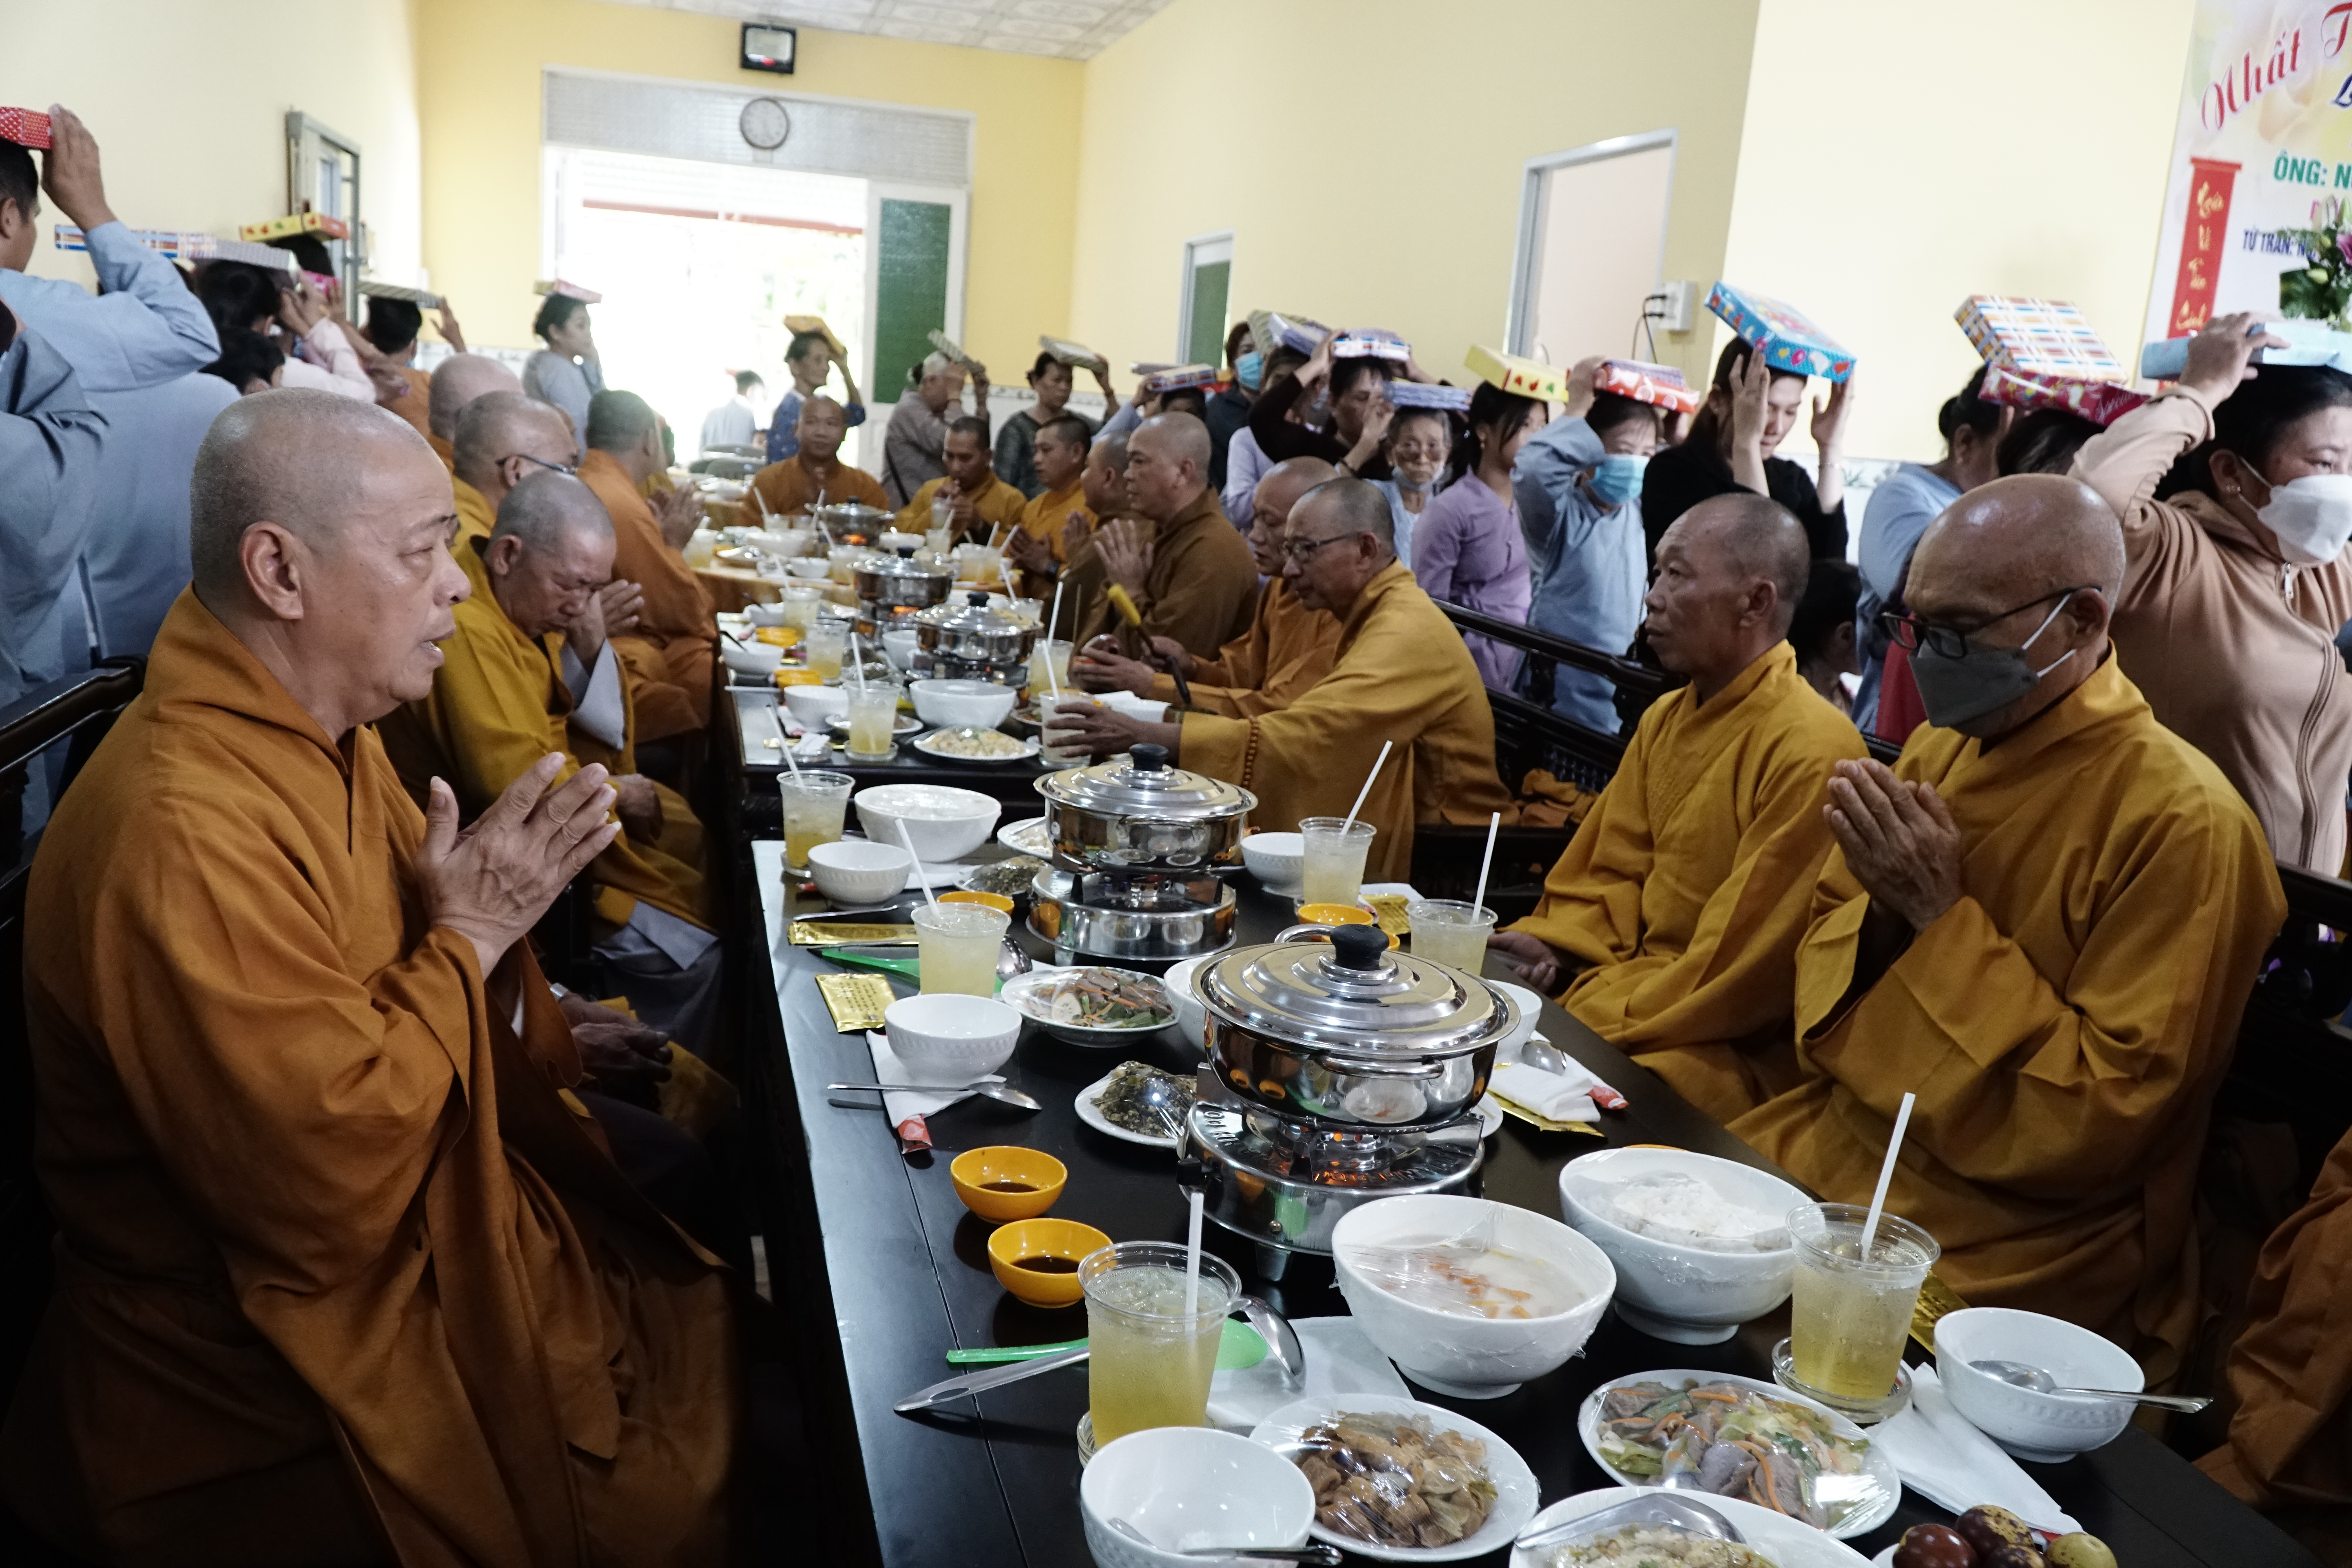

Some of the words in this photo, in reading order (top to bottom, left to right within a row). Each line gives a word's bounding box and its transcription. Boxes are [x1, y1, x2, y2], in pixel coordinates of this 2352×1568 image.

[2201, 27, 2303, 131] Nhất
[2274, 150, 2327, 186] ÔNG:
[2334, 162, 2352, 189] N
